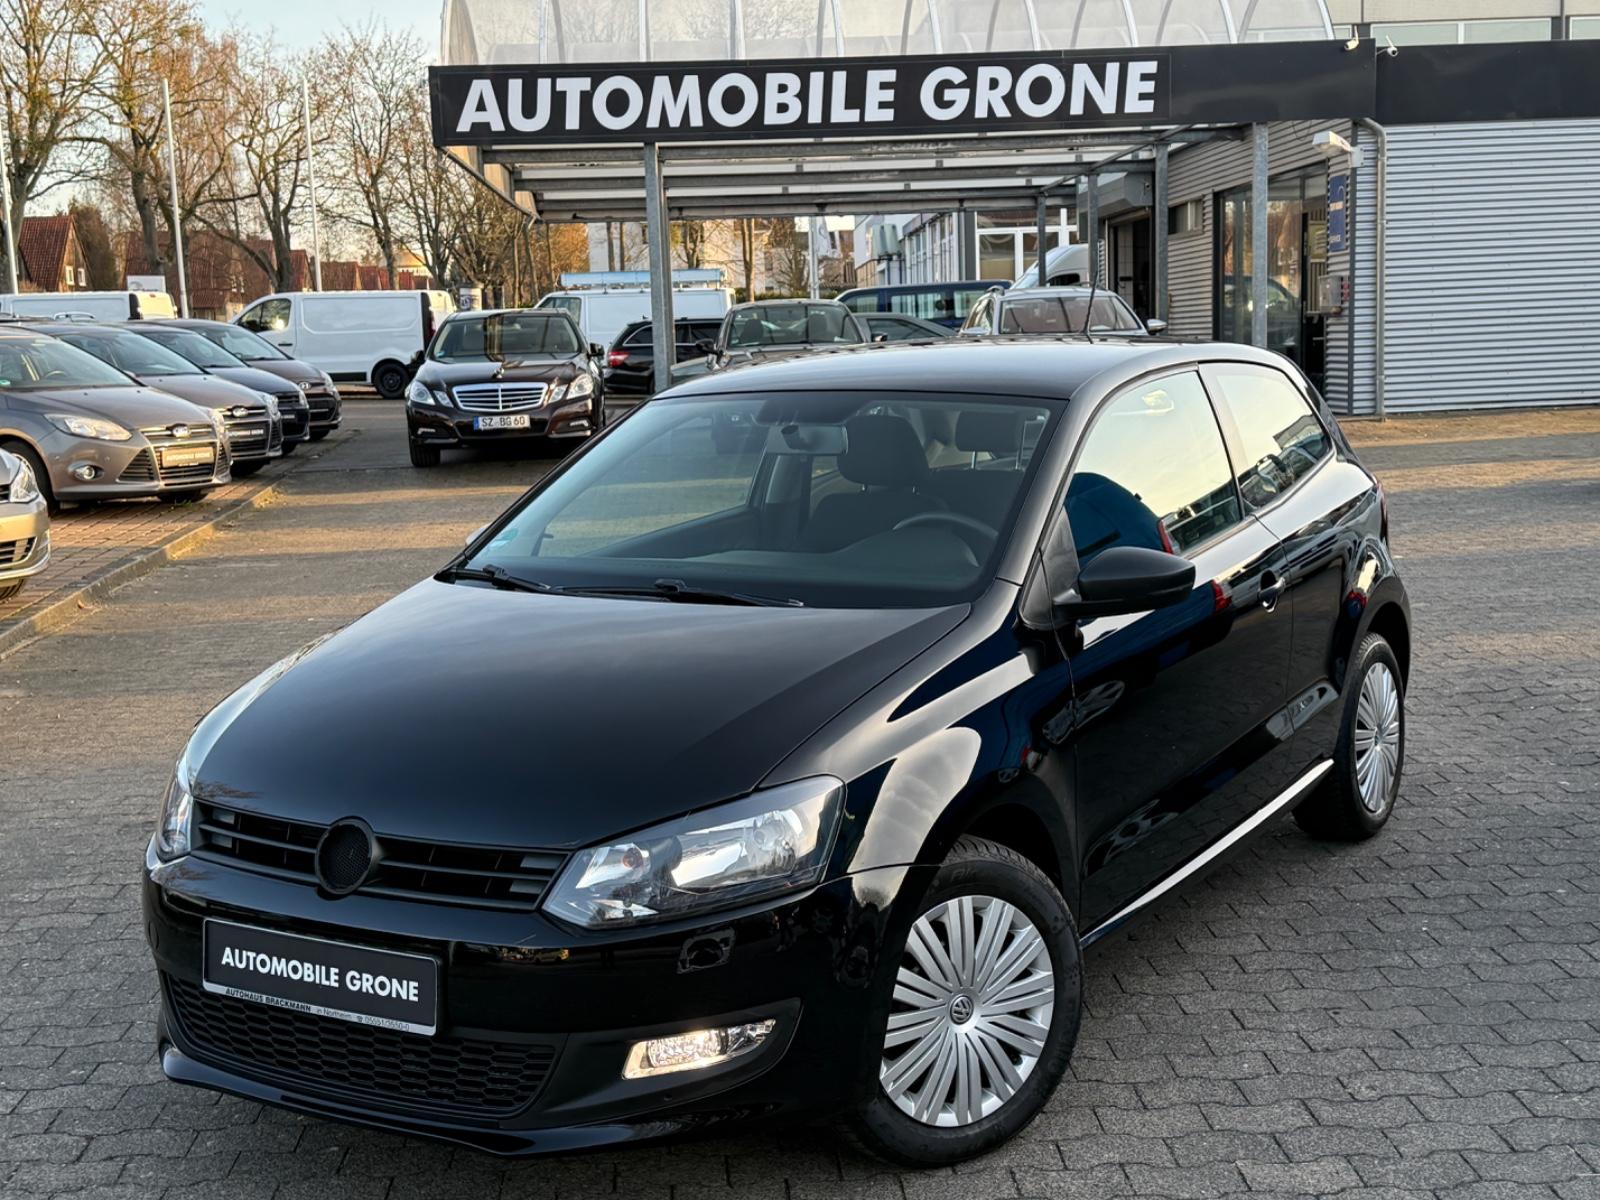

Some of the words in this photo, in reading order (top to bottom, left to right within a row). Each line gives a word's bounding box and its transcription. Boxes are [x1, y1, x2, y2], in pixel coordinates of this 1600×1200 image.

[456, 69, 897, 132] AUTOMOBILE
[920, 61, 1158, 121] GRONE
[482, 417, 493, 427] SZ
[513, 416, 525, 425] 60
[221, 947, 339, 987] AUTOMOBILE
[345, 970, 418, 1002] GRONE
[225, 987, 265, 1003] AUTOHAUS
[265, 997, 311, 1012] BRACKMANN
